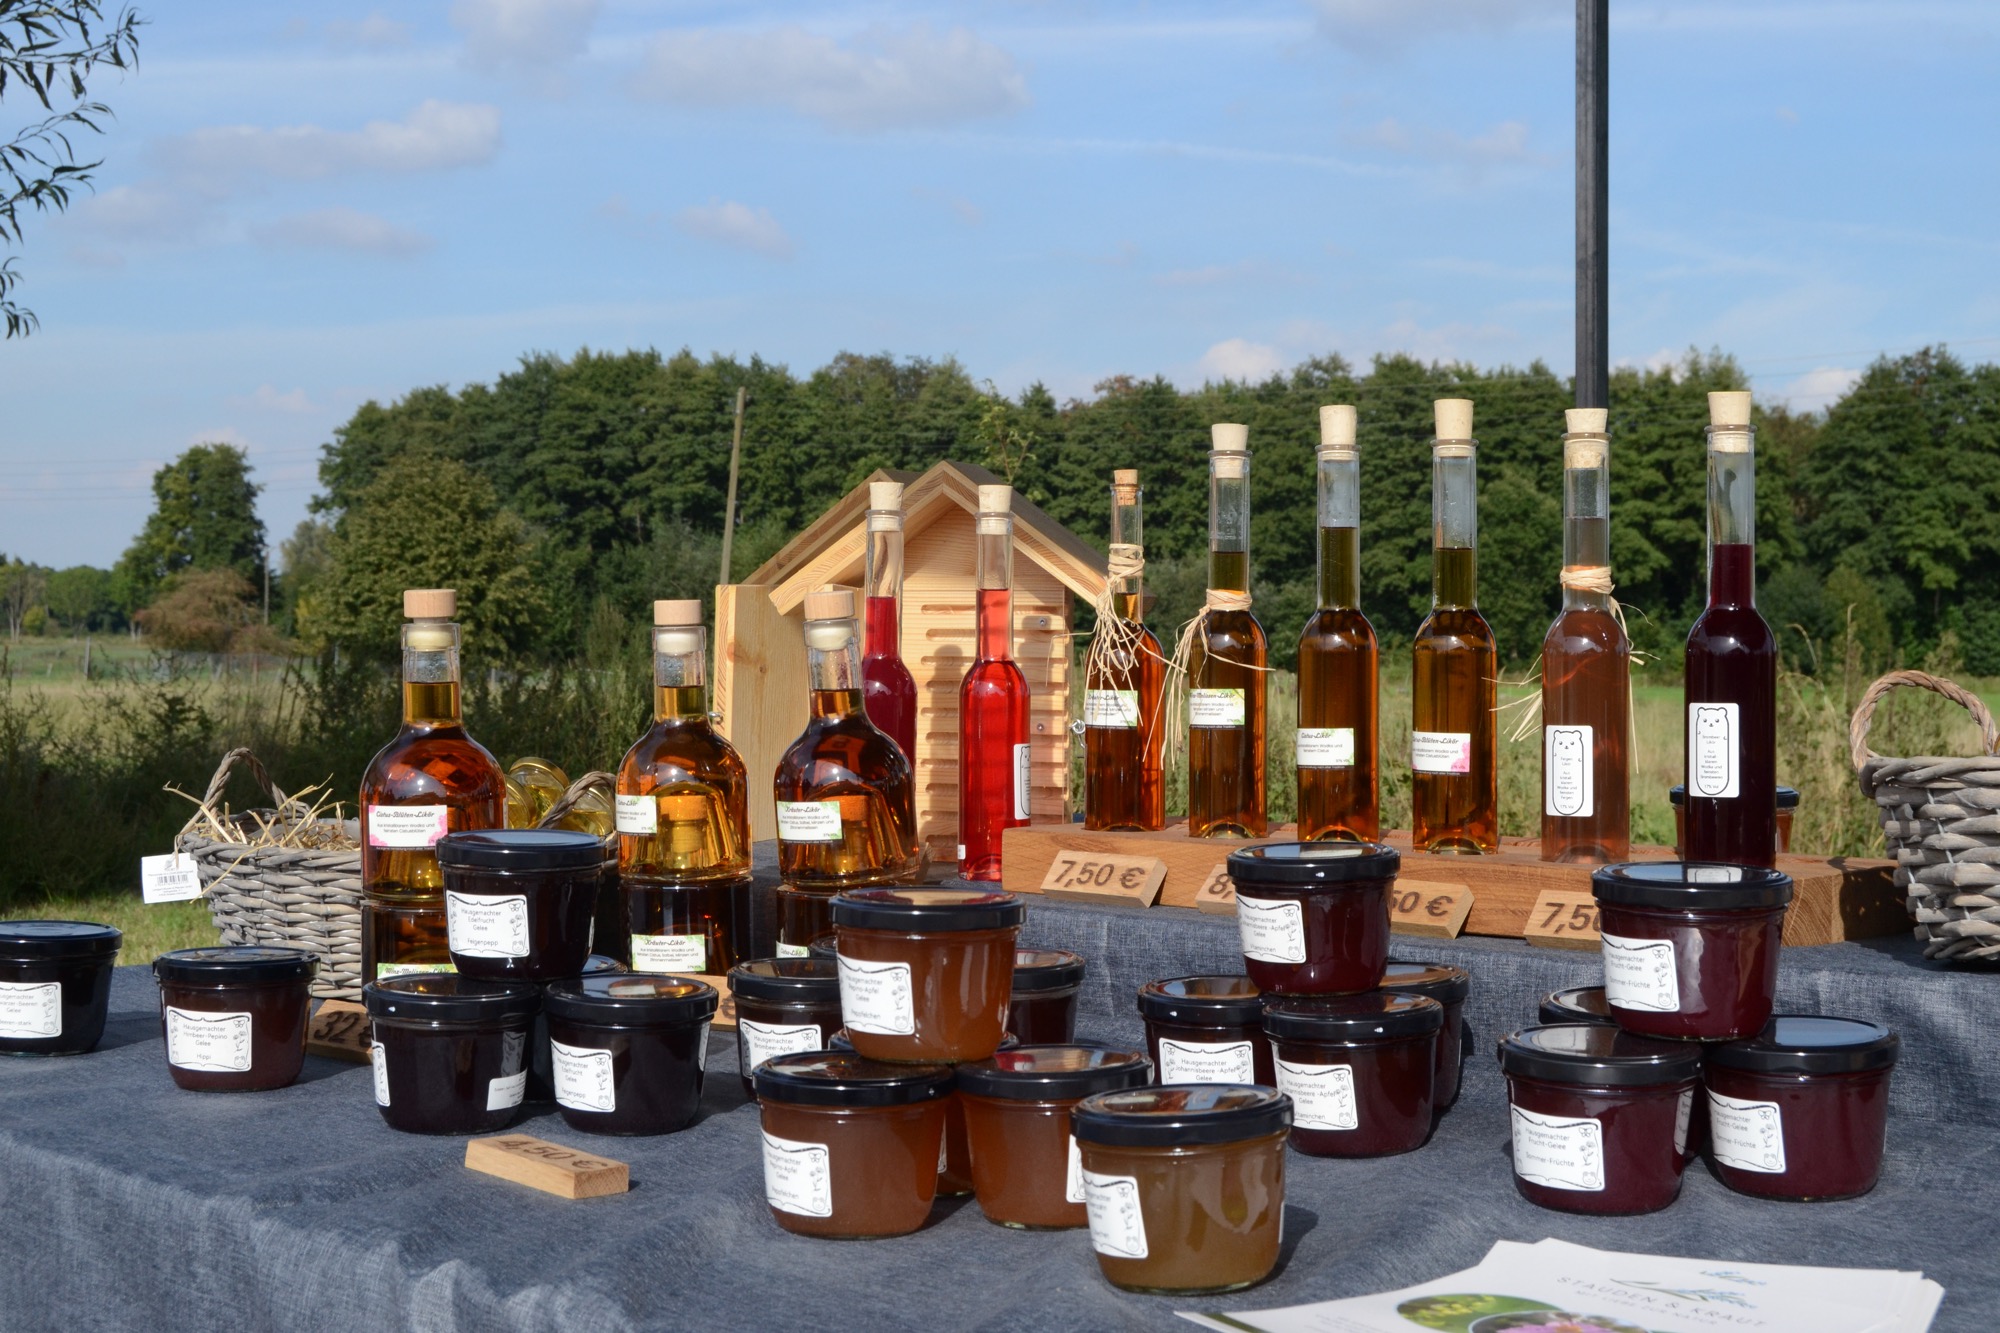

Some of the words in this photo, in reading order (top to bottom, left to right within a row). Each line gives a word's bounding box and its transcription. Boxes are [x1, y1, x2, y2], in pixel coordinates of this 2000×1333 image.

[376, 810, 434, 818] Cistus-Blüten-Likör
[1054, 860, 1114, 888] 7,50
[1119, 867, 1145, 889] €
[1425, 895, 1453, 917] €
[461, 908, 502, 917] Hausgemachter
[183, 1023, 226, 1032] Hausgemachter
[314, 1010, 360, 1044] 32
[753, 1035, 794, 1044] Hausgemachter
[754, 1043, 794, 1053] Brombeer-Apfel
[196, 1053, 212, 1061] Hippi
[1181, 1058, 1227, 1067] Hausgemachter
[1286, 1079, 1326, 1089] Hausgemachter
[1298, 1097, 1314, 1105] Gelee
[1525, 1127, 1570, 1141] Hausgemachter
[1528, 1137, 1567, 1150] Frucht-Gelee
[1526, 1151, 1575, 1168] Sommer-Früchte
[1557, 1276, 1657, 1303] STAUDEN
[1692, 1307, 1767, 1327] KRAUT
